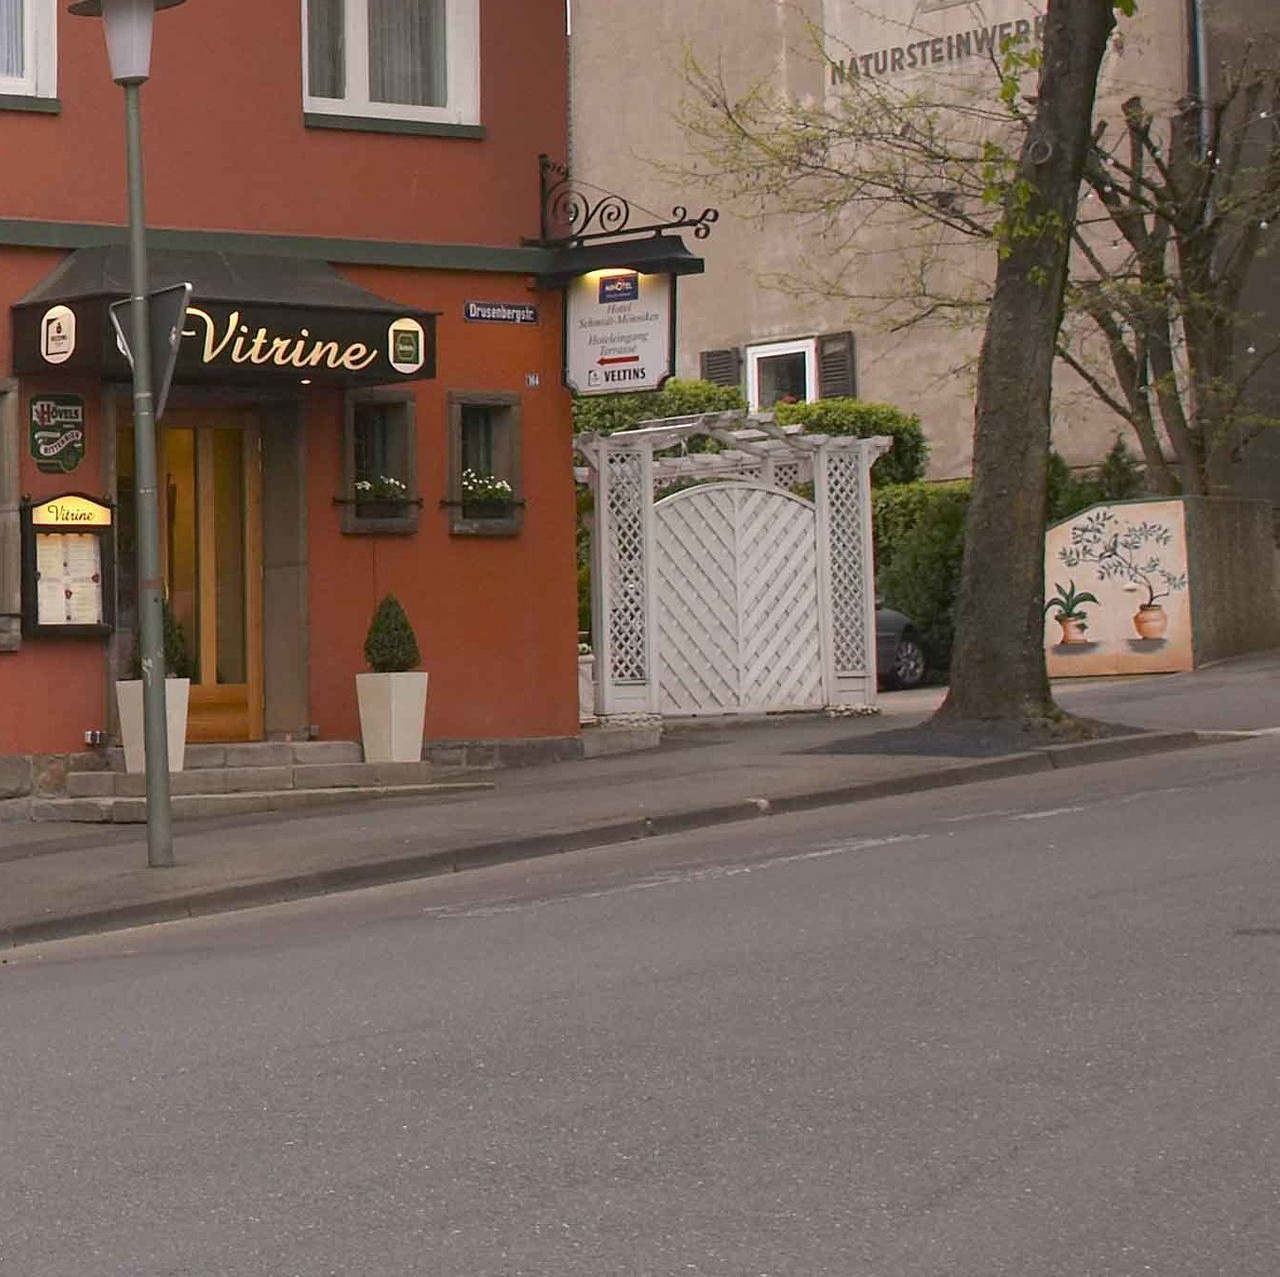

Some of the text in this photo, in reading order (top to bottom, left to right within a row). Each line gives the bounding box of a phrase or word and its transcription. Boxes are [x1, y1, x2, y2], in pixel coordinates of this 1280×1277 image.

[181, 307, 378, 371] Vitrine
[604, 367, 646, 382] VELTINS
[47, 504, 94, 522] Vitrine
